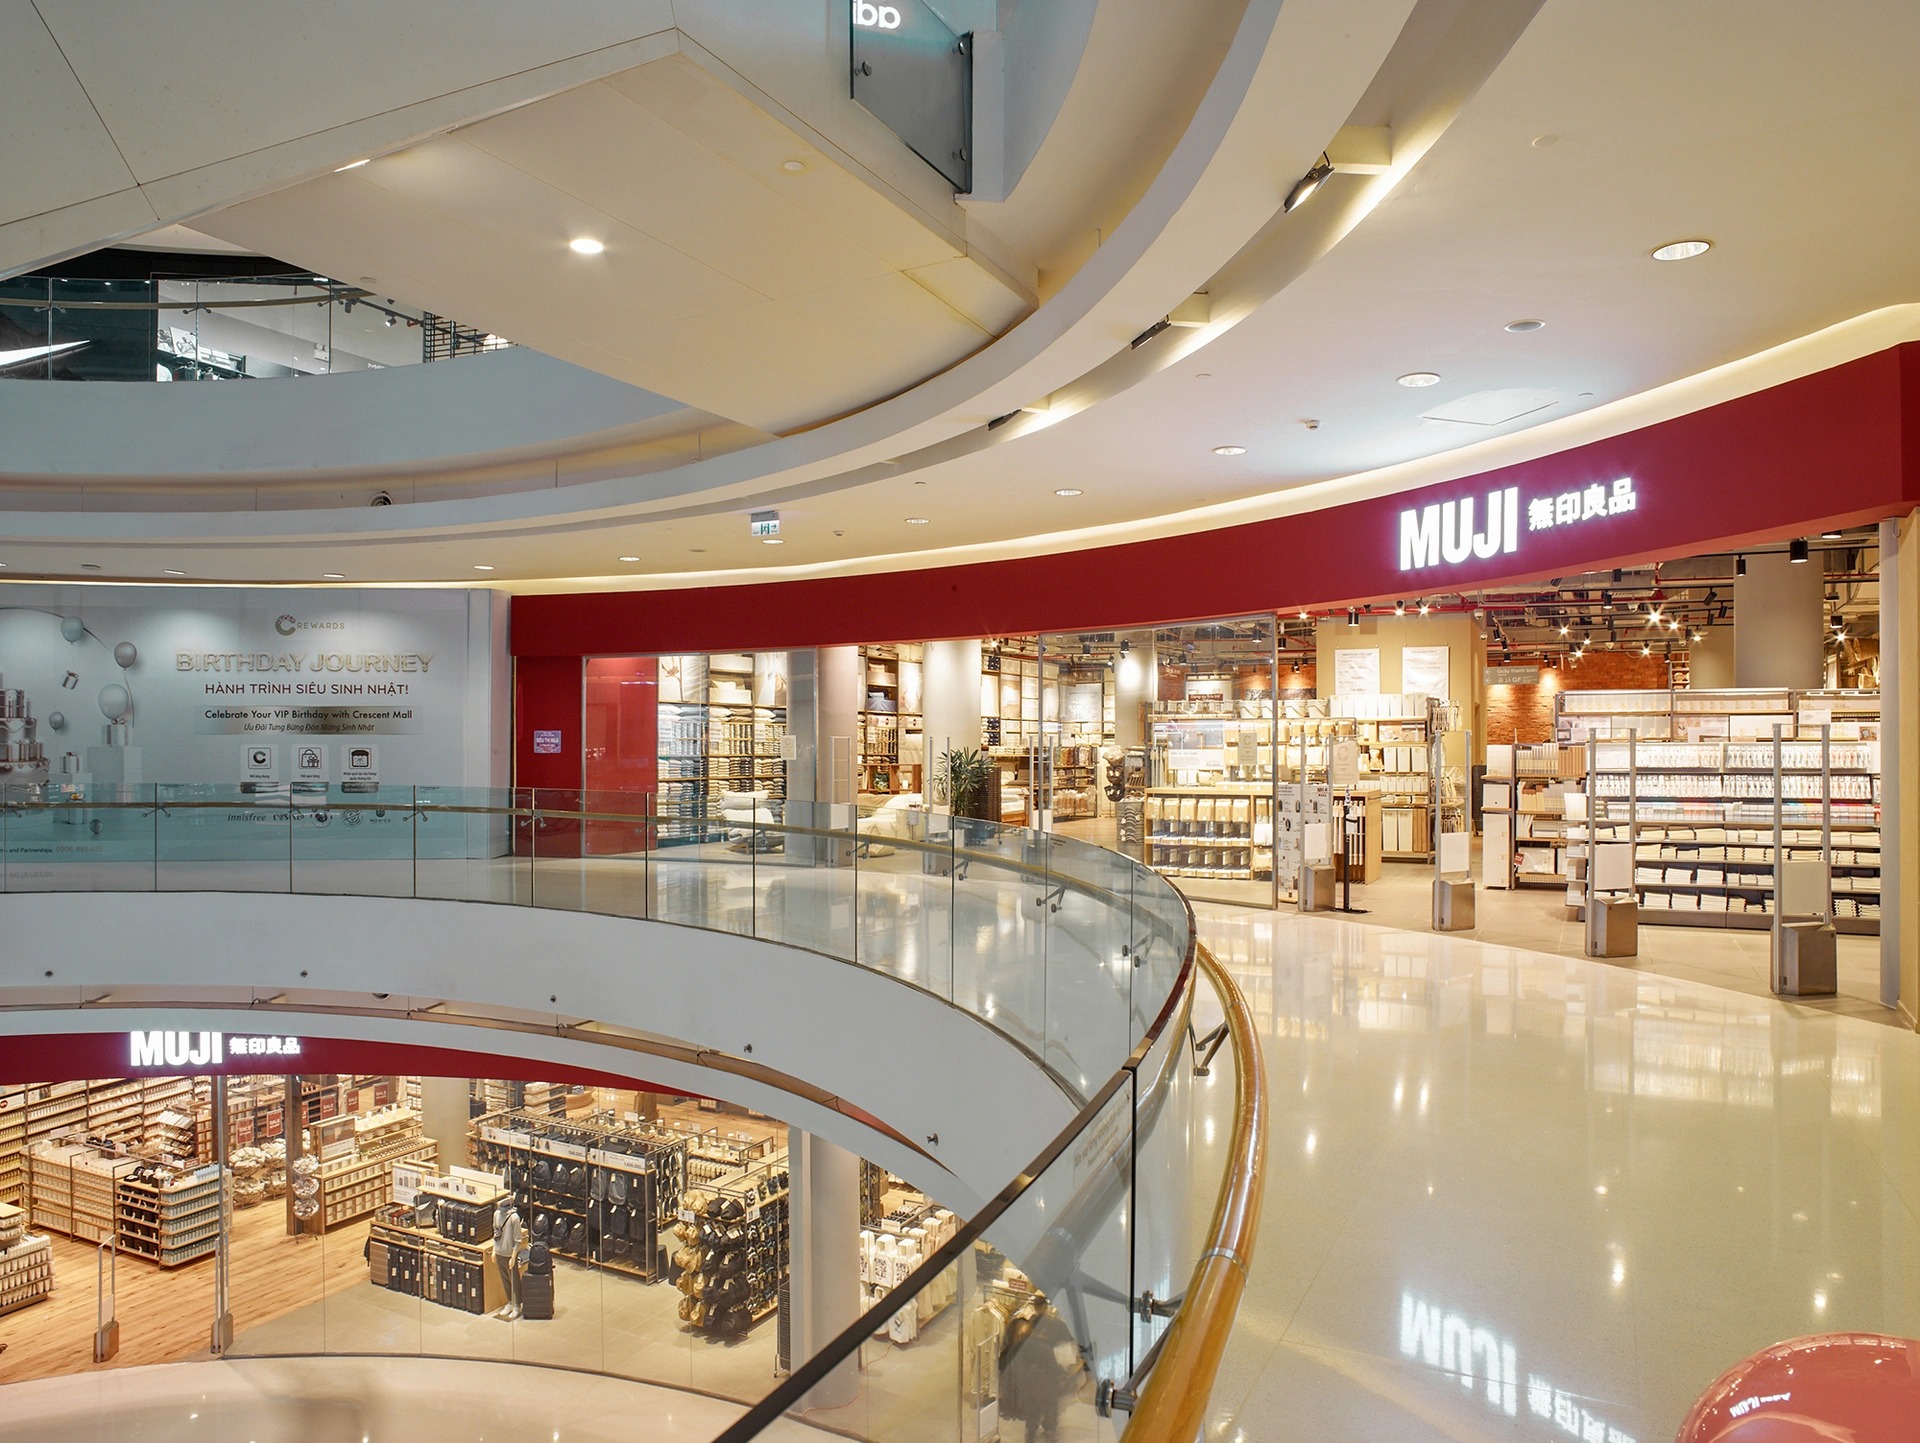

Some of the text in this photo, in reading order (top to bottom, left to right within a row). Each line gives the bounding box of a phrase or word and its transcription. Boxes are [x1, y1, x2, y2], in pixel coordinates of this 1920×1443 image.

[1400, 477, 1637, 570] MUJI 無印良品
[297, 622, 345, 630] REWARDS
[176, 651, 433, 673] BIRTHDAY JOURNEY
[205, 682, 409, 697] HÀNH TRÌNH SIÊU SINH NHẬT!
[205, 709, 413, 721] Celebrate Your VIP Birthday with Crescent Mall
[341, 723, 356, 731] Sinh
[228, 813, 267, 822] innisfree
[130, 1031, 301, 1067] MUJI 無印良品
